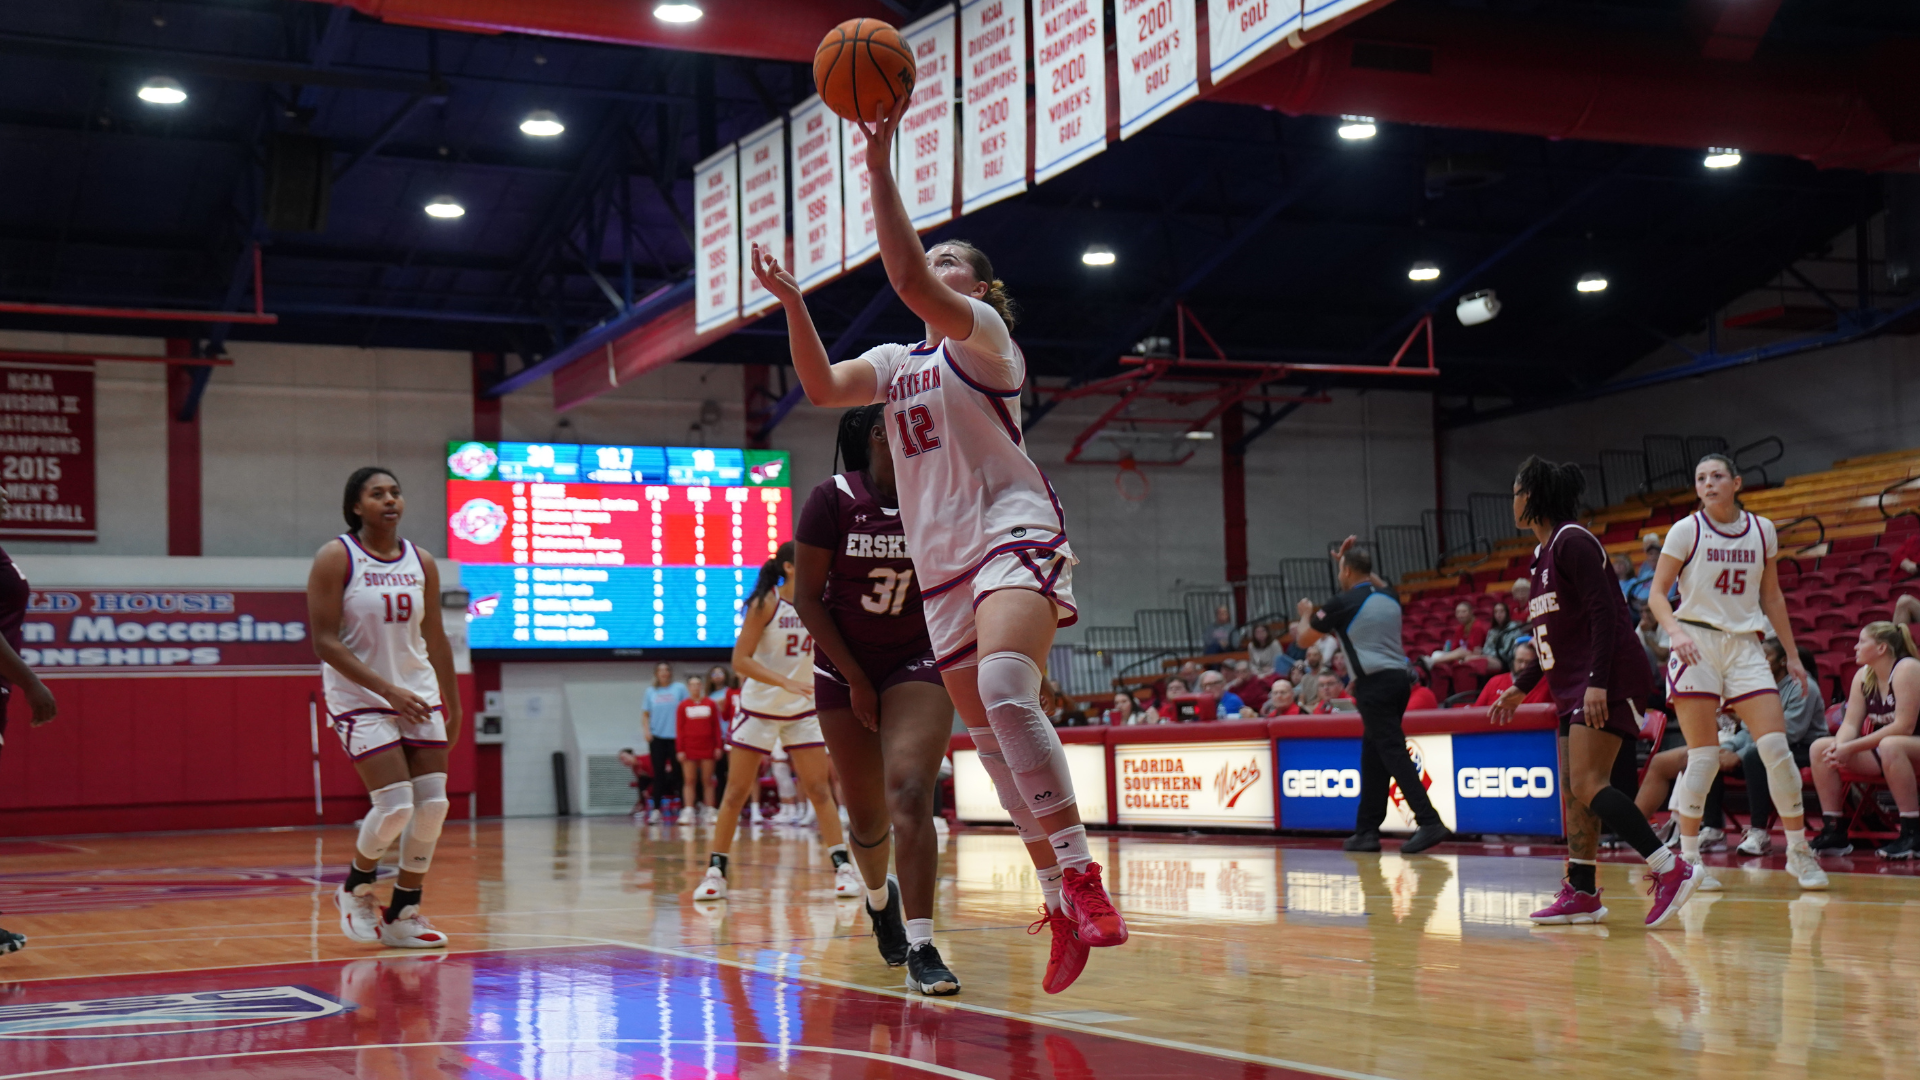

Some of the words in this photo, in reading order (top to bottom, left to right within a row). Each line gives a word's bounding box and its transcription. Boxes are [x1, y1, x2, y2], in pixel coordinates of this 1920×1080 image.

[1138, 0, 1172, 43] 2001
[1241, 0, 1268, 32] GOLF
[1039, 18, 1096, 66] CHAMPIONS
[1131, 30, 1180, 74] WOMEN'S
[1052, 54, 1085, 95] 2000
[1146, 62, 1170, 94] GOLF
[1049, 87, 1091, 123] WOMEN'S
[1059, 116, 1081, 143] GOLF
[8, 372, 54, 391] NCAA
[0, 414, 71, 434] ATIONAL
[895, 404, 941, 458] 12
[3, 454, 62, 480] 2015
[6, 483, 59, 501] MEN'S
[2, 503, 85, 522] SKETBALL
[1707, 548, 1755, 564] SOUTHERN
[861, 567, 914, 615] 31
[1714, 568, 1747, 595] 45
[90, 592, 235, 614] HOUSE
[381, 591, 412, 624] 19
[69, 614, 306, 643] Moccasins
[20, 647, 220, 667] ONSHIPS
[786, 633, 813, 657] 24
[1123, 758, 1184, 773] FLORIDA
[1124, 776, 1202, 791] SOUTHERN
[1214, 755, 1261, 808] Mocs
[1282, 768, 1361, 798] GEICO
[1457, 766, 1554, 798] GEICO
[1125, 794, 1189, 809] COLLEGE
